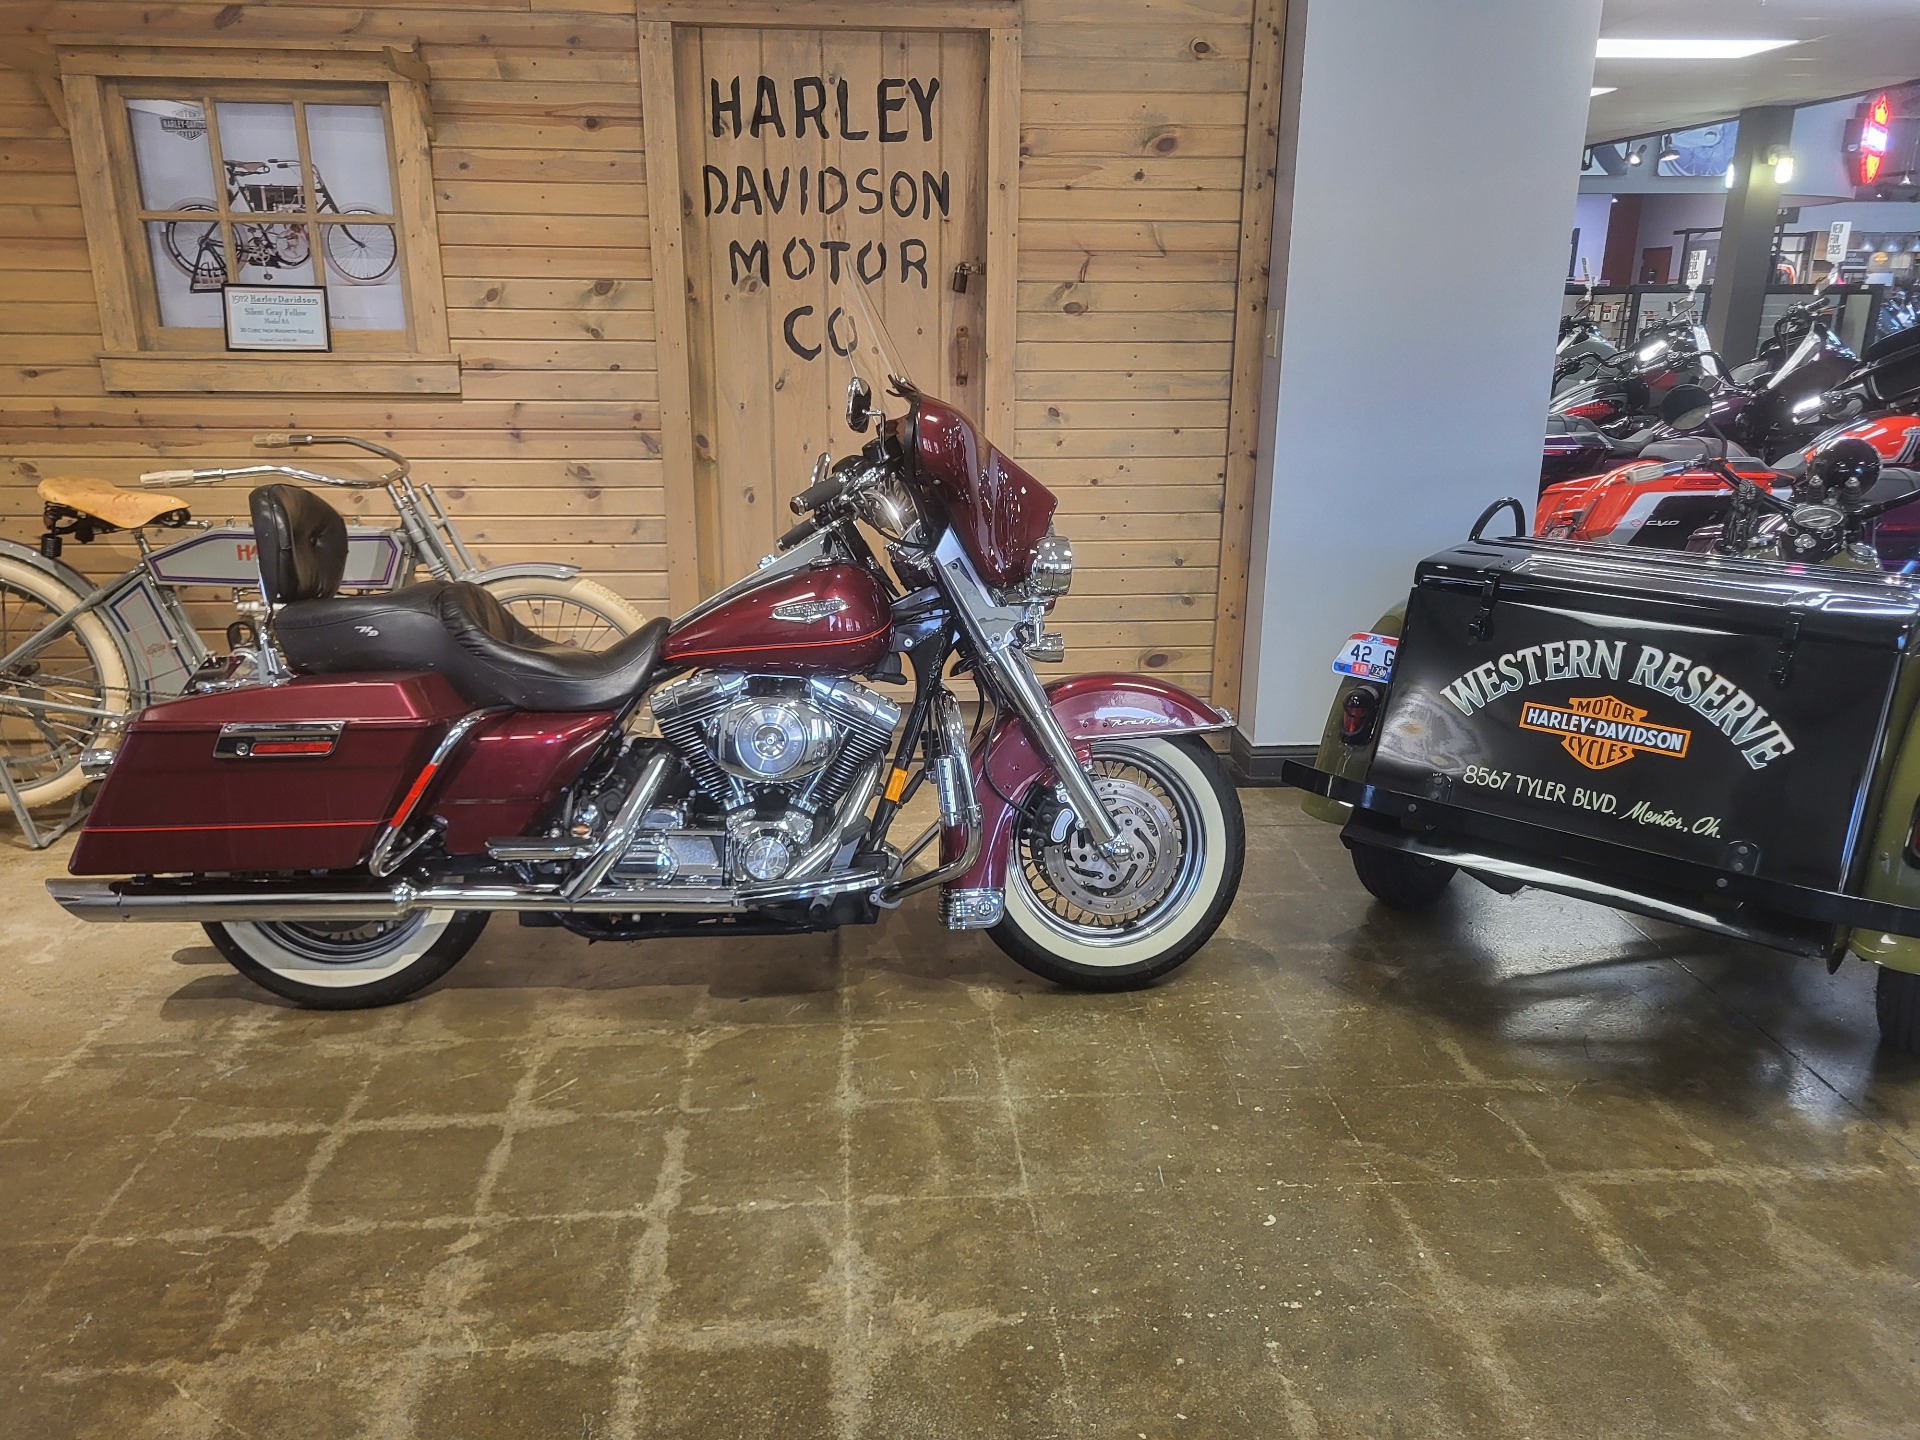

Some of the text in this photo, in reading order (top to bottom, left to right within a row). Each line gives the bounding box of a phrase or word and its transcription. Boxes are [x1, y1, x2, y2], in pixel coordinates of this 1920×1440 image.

[711, 75, 940, 143] HARLEY
[702, 165, 950, 220] DAVIDSON
[729, 236, 928, 289] MOTOR
[244, 308, 265, 316] Silent
[284, 308, 307, 317] Fellow
[783, 305, 858, 361] CO
[1351, 644, 1372, 663] 42
[1354, 663, 1367, 673] 18
[1439, 639, 1795, 770] WESTERN RESERVE
[1576, 698, 1635, 722] MOTOR
[1526, 708, 1684, 751] HARLEY-DAVIDSON
[1568, 735, 1629, 767] CYCLES
[1462, 765, 1722, 839] 8567 TYLER BLVD. Mentor, Oh.
